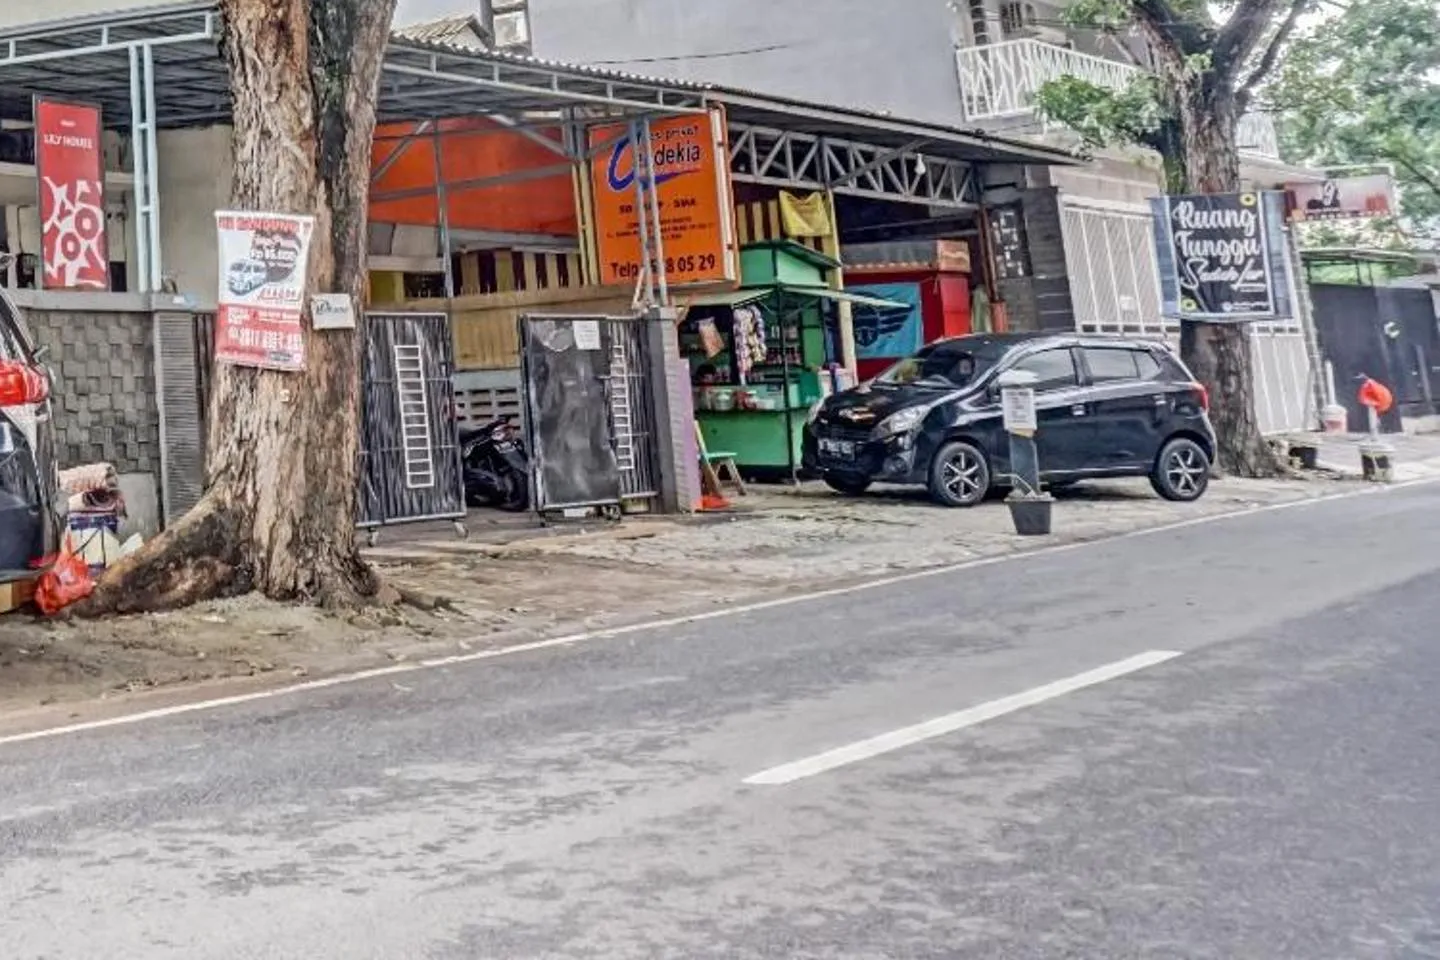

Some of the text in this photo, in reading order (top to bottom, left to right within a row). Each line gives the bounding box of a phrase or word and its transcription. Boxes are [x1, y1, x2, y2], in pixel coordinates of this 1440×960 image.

[608, 132, 701, 191] Cdekia
[1172, 201, 1257, 236] Ruang
[678, 255, 694, 271] 05
[699, 253, 715, 270] 29
[1175, 230, 1260, 265] Tunggu
